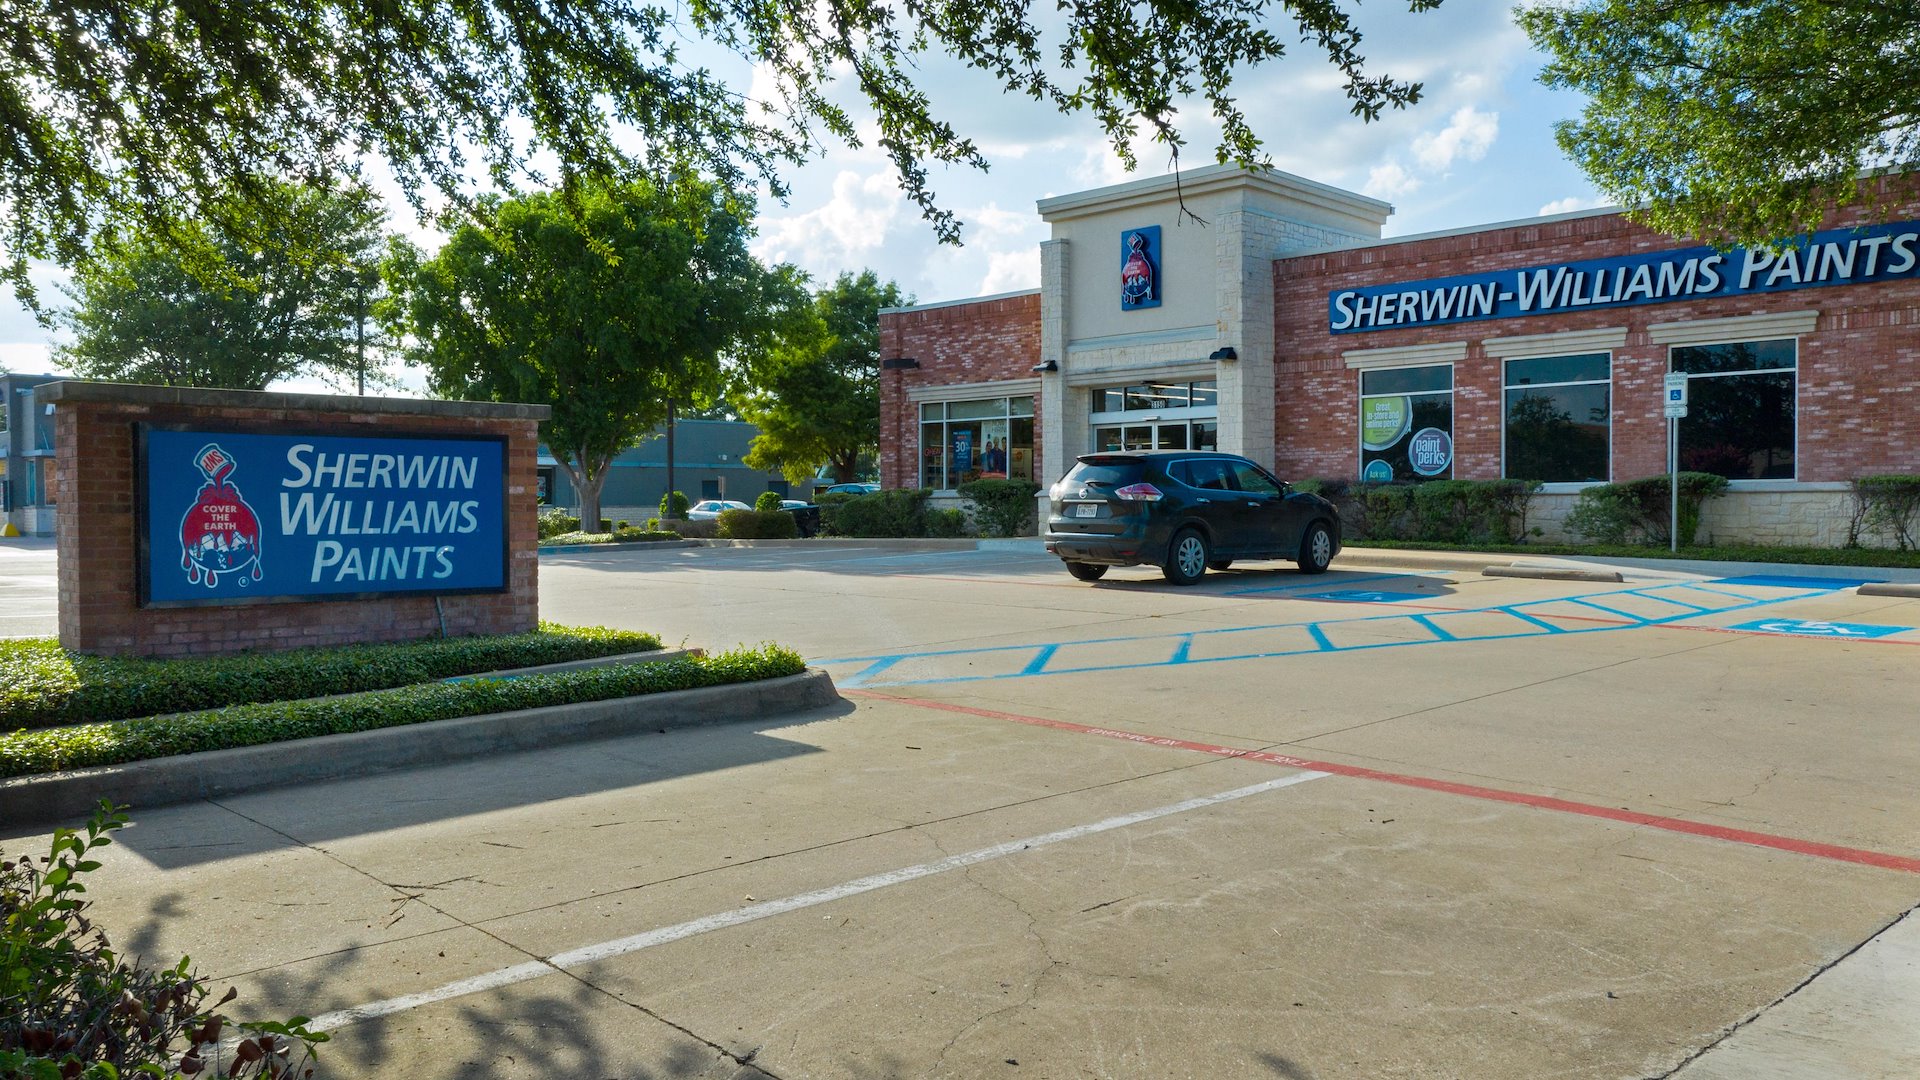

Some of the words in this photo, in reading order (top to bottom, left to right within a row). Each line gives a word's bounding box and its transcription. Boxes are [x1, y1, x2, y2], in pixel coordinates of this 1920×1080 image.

[1331, 255, 1722, 330] SHERWIN-WILLIAMS
[1738, 233, 1919, 289] PAINTS
[1375, 403, 1391, 411] Great
[1416, 437, 1440, 453] paint
[203, 451, 224, 472] SWP
[281, 443, 479, 489] SHERWIN
[1418, 451, 1445, 466] perks
[202, 505, 238, 513] COVER
[279, 492, 479, 536] WILLIAMS
[211, 513, 230, 522] THE
[204, 522, 237, 530] EARTH
[310, 540, 455, 583] PAINTS
